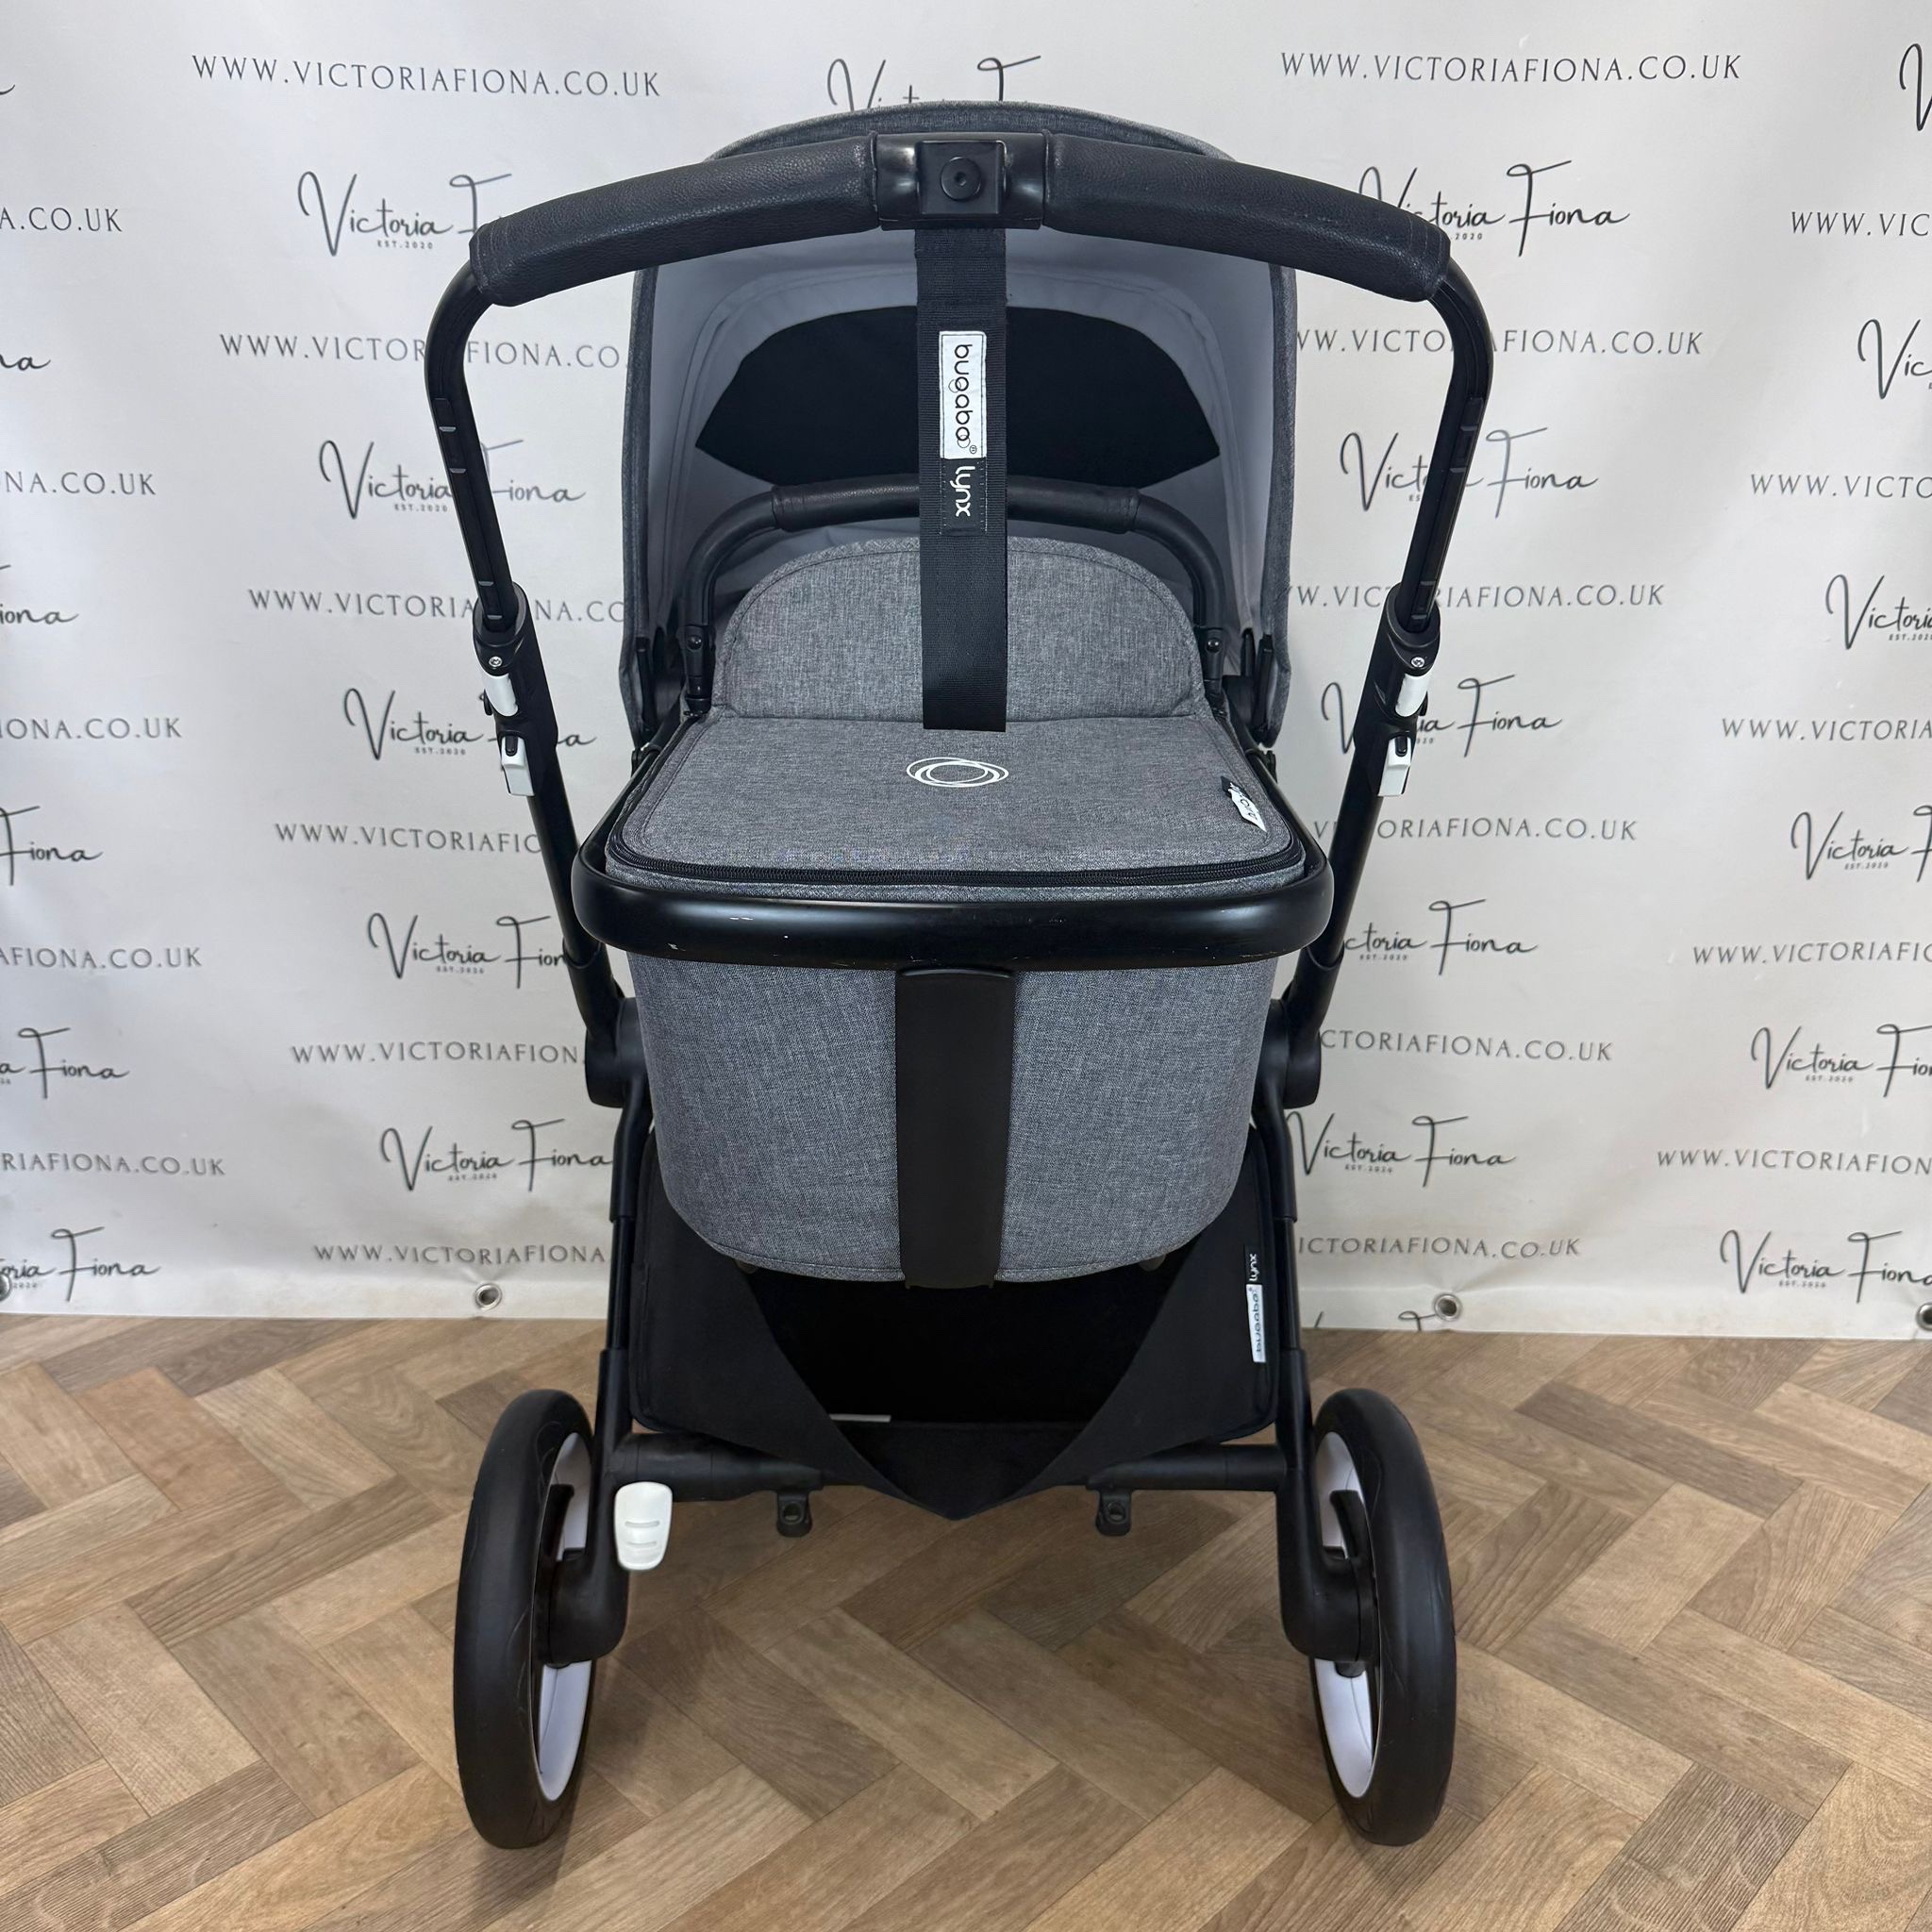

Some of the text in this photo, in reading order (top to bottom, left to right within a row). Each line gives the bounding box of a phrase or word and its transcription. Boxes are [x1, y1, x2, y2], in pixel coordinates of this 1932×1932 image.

[192, 55, 660, 96] WWW.VICTORIAFIONA.CO.UK
[1280, 52, 1741, 83] WWW.VICTORIAFIONA.CO.UK
[298, 171, 453, 257] Victoria
[1507, 160, 1630, 257] Fiona
[950, 465, 975, 517] lynx
[1486, 427, 1599, 519] Fiona
[343, 688, 483, 760] Victoria
[1457, 675, 1562, 758] Fiona
[1790, 810, 1909, 880] Victoria
[368, 912, 501, 978] Victoria
[1428, 898, 1539, 975] Fiona
[18, 1027, 129, 1099] Fiona
[1751, 1025, 1874, 1090] Victoria
[381, 1118, 612, 1192] Victoria Fiona
[1286, 1110, 1517, 1187] Victoria Fiona
[51, 1226, 160, 1303] Fiona
[1720, 1229, 1845, 1293] Victoria
